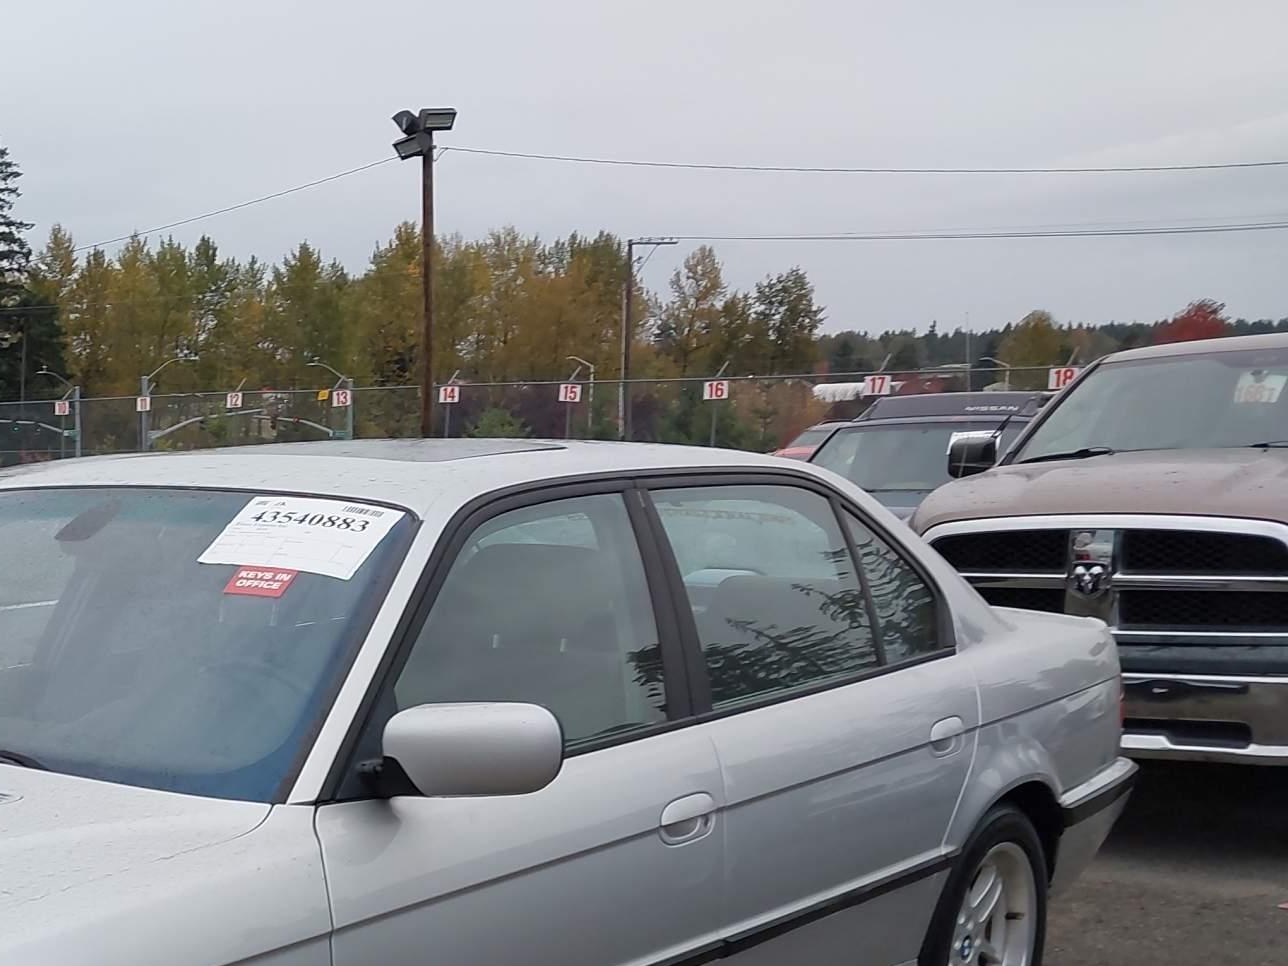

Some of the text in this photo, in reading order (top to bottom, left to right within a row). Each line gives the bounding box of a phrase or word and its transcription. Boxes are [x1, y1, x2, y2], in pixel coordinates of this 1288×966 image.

[707, 382, 724, 398] 16
[870, 377, 885, 394] 17
[229, 393, 239, 406] 12
[336, 391, 348, 405] 13
[442, 387, 456, 401] 14
[564, 386, 577, 400] 15
[139, 398, 148, 410] 11
[251, 510, 370, 532] 43540883
[238, 570, 292, 581] KEYS IN
[235, 579, 283, 590] OFFICE
